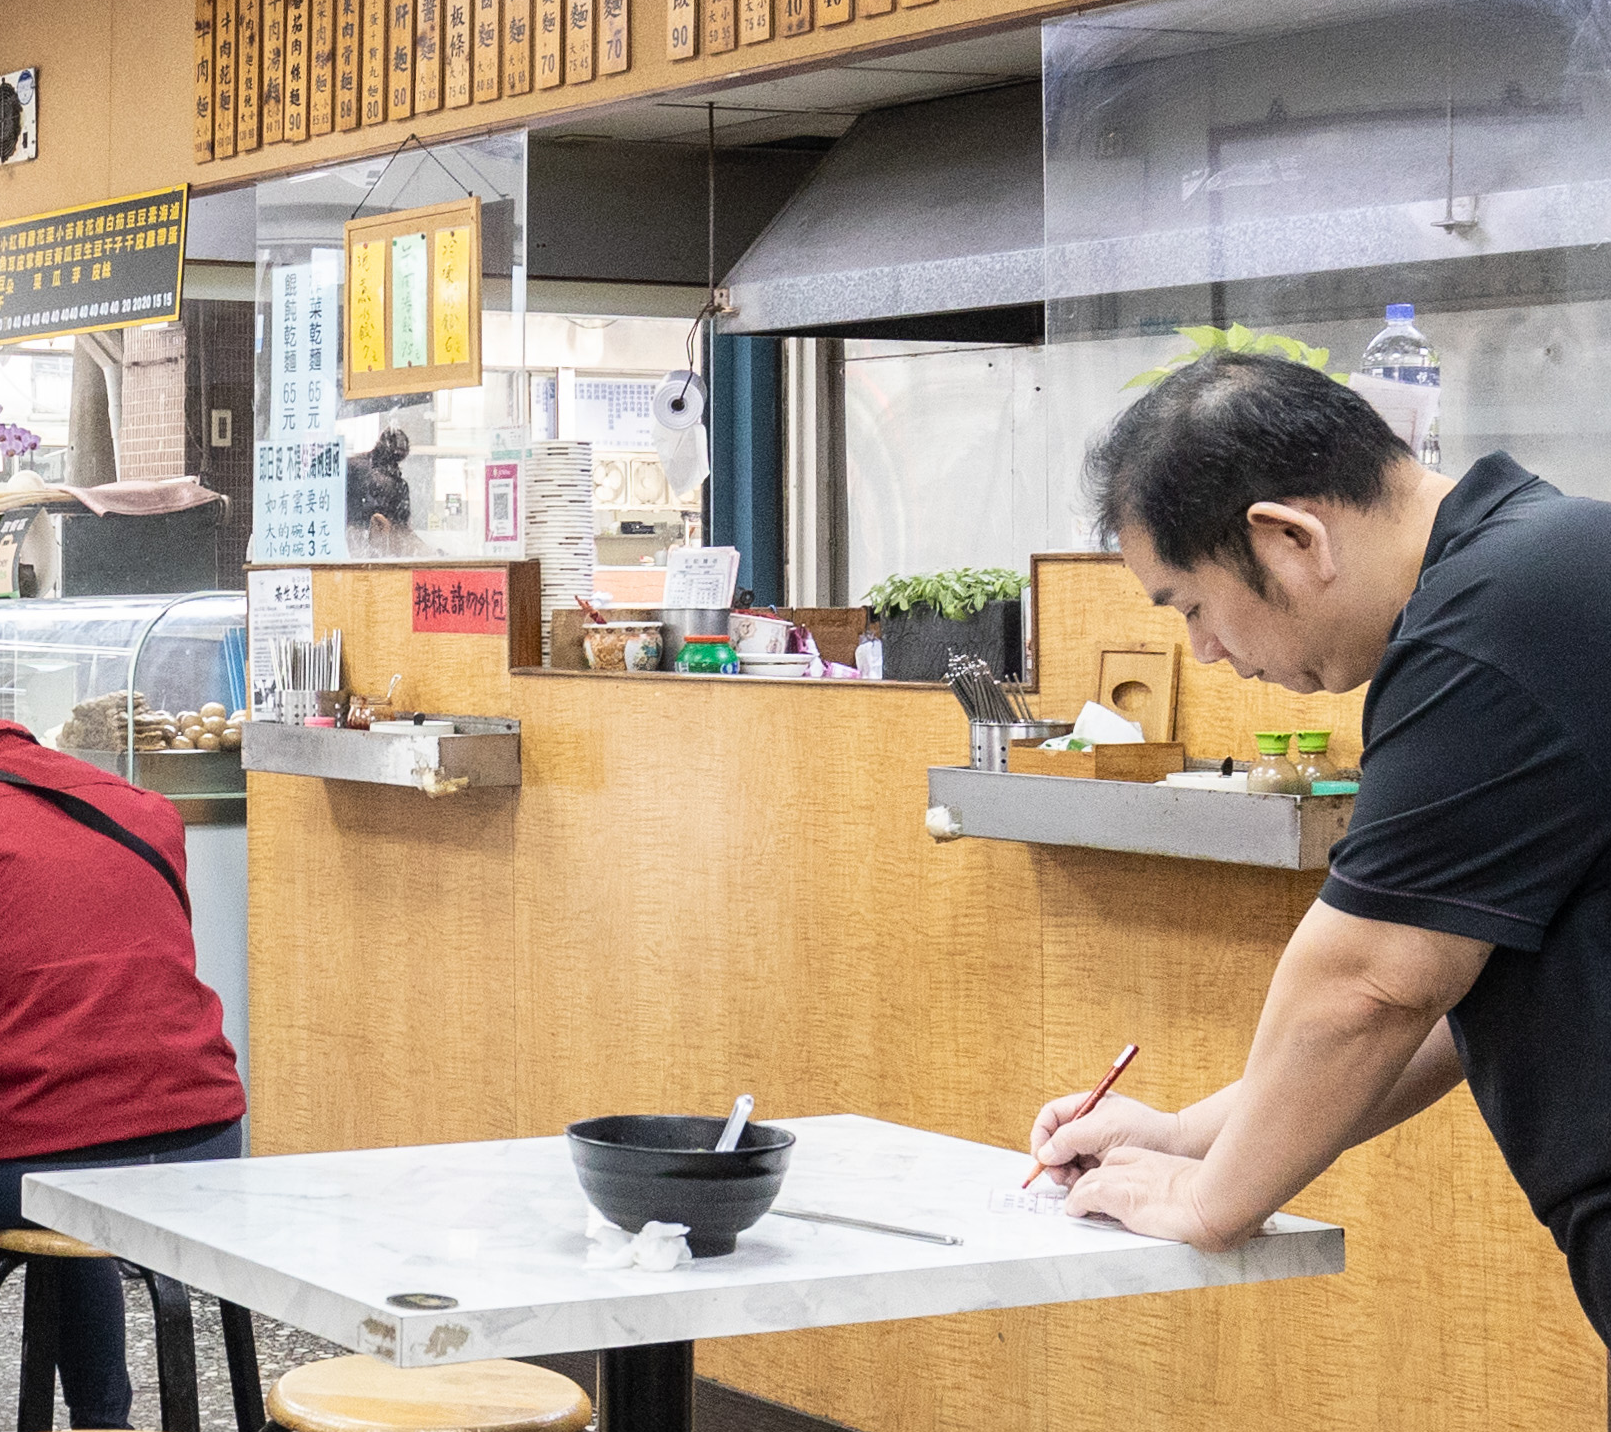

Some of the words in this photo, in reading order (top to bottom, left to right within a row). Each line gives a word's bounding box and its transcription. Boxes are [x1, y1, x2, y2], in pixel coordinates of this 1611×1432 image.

[708, 11, 716, 23] 大
[721, 7, 730, 20] 小
[745, 0, 754, 12] 大
[744, 17, 754, 30] 75
[757, 13, 766, 27] 45
[570, 43, 577, 53] 大
[580, 40, 588, 52] 小
[672, 26, 687, 48] 90
[607, 38, 622, 59] 70
[541, 53, 555, 75] 70
[569, 58, 577, 71] 75
[580, 56, 588, 69] 45
[394, 89, 406, 106] 80
[449, 85, 456, 97] 75
[459, 83, 466, 95] 45
[367, 102, 378, 118] 80
[289, 113, 301, 131] 90
[114, 213, 124, 253] 茄子
[125, 211, 136, 251] 豆干
[135, 209, 146, 250] 豆皮
[157, 205, 168, 246] 海帶
[168, 202, 179, 244] 滷蛋
[122, 299, 130, 313] 20
[133, 297, 141, 311] 20
[141, 295, 151, 309] 20
[153, 294, 161, 307] 15
[163, 292, 172, 306] 15
[284, 273, 297, 373] 餛飩乾麵
[309, 276, 322, 371] 菜乾麵
[282, 382, 296, 430] 65元
[308, 381, 321, 429] 65元
[265, 489, 330, 515] 如有需要的
[415, 582, 505, 621] 辣椒請勿外包
